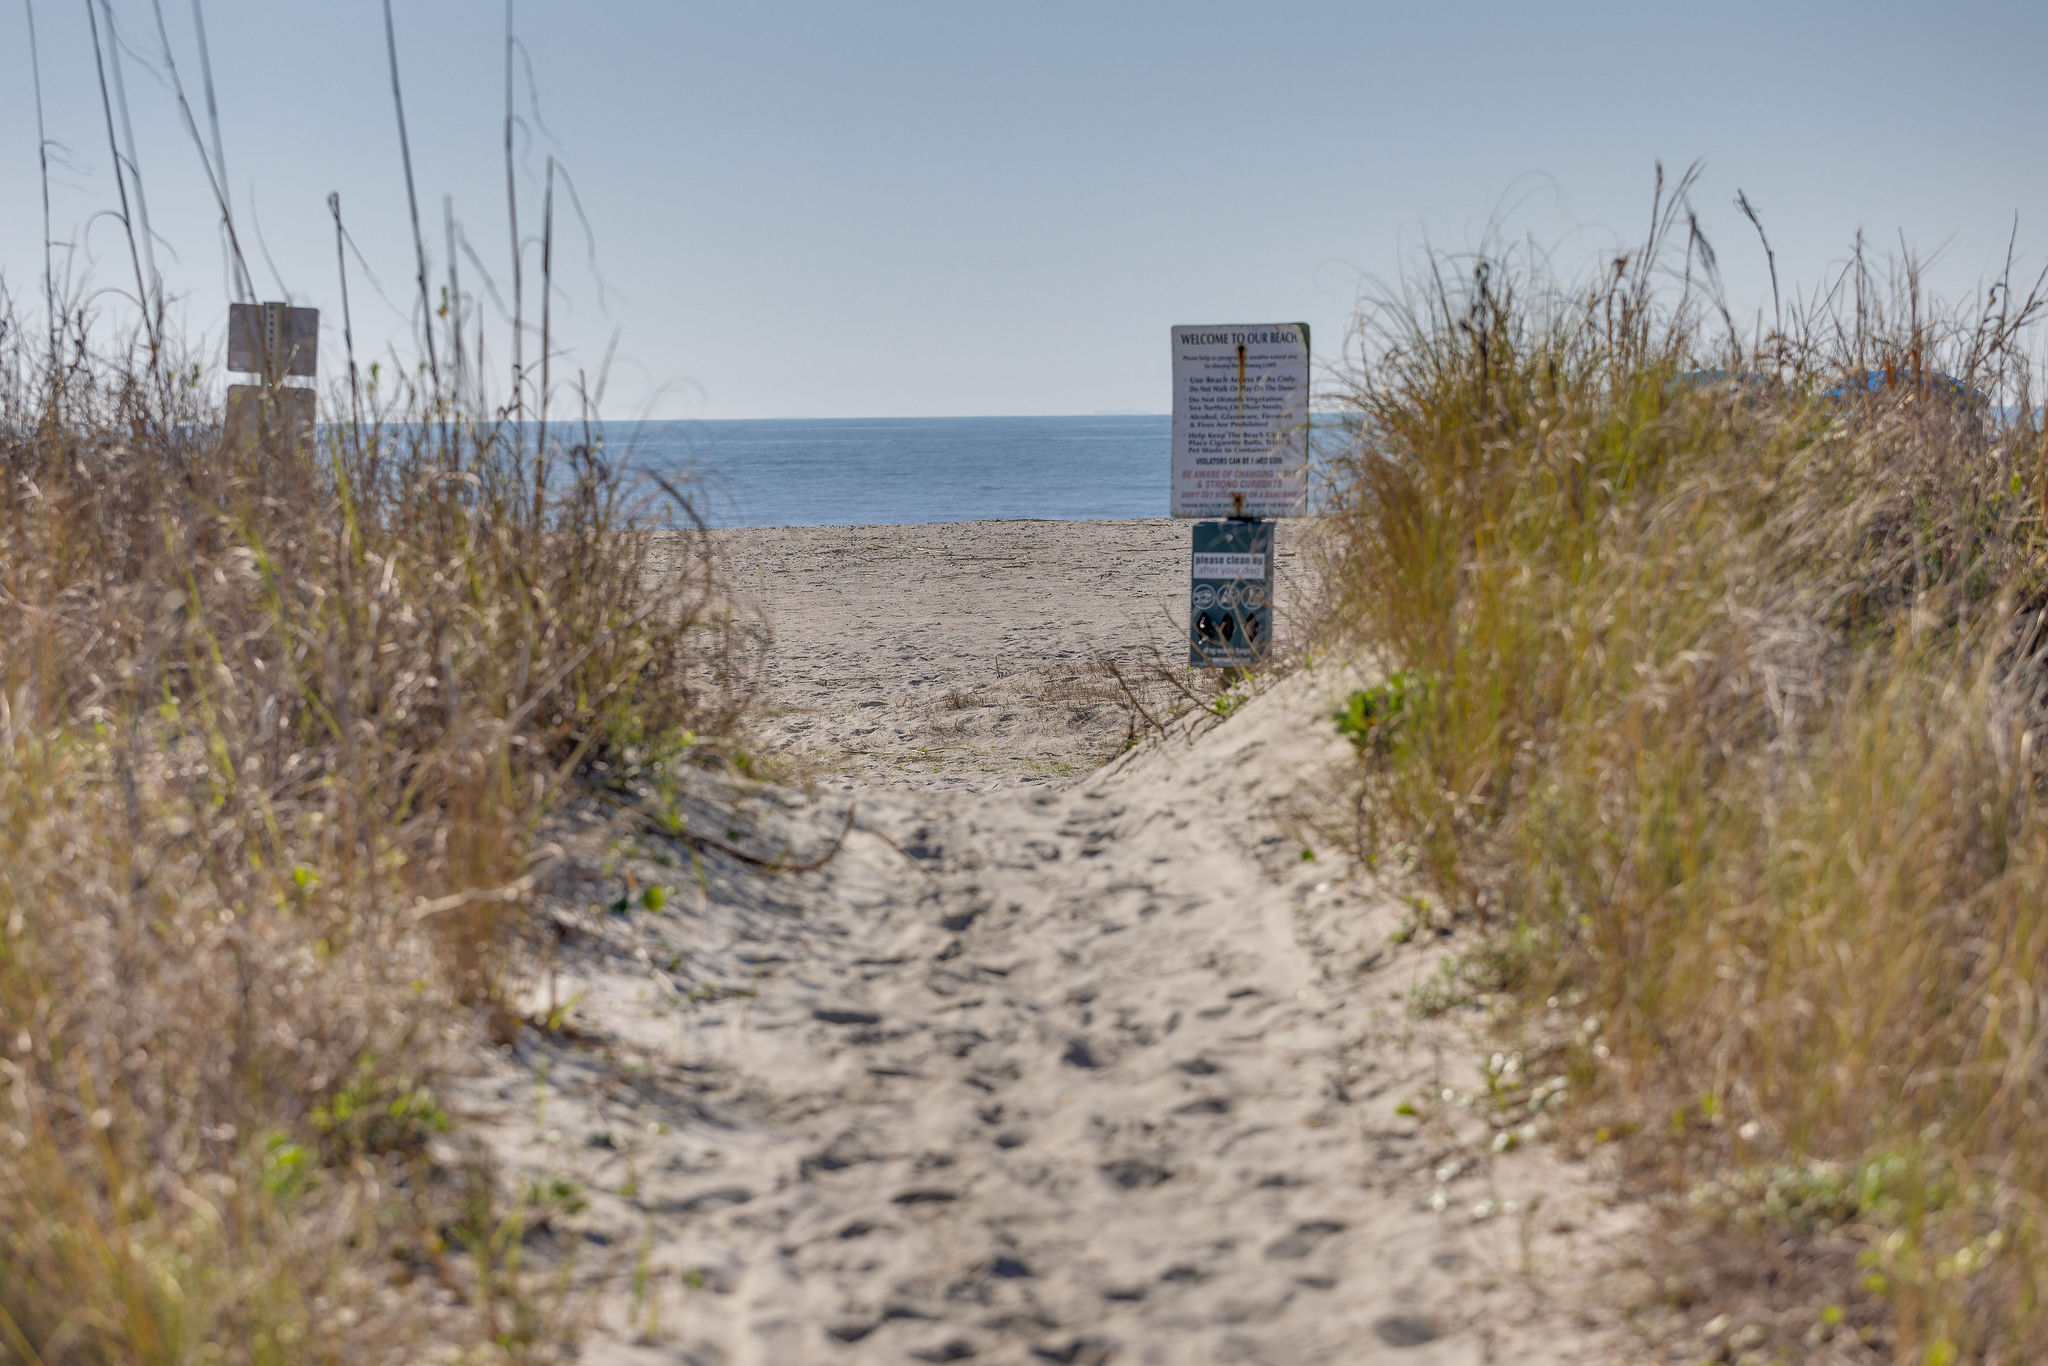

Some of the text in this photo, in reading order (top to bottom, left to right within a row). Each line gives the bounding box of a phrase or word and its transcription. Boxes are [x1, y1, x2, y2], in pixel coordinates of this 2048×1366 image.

[1180, 332, 1298, 344] WELCOME TO OUR BEACH
[1182, 470, 1192, 478] BE
[1194, 470, 1220, 478] AWARE
[1222, 470, 1232, 478] OF
[1234, 470, 1273, 478] CHANGING
[1206, 480, 1237, 488] STRONG
[1240, 480, 1282, 488] CURRENTS
[1196, 556, 1224, 564] please
[1227, 556, 1250, 564] clean
[1221, 568, 1240, 576] your
